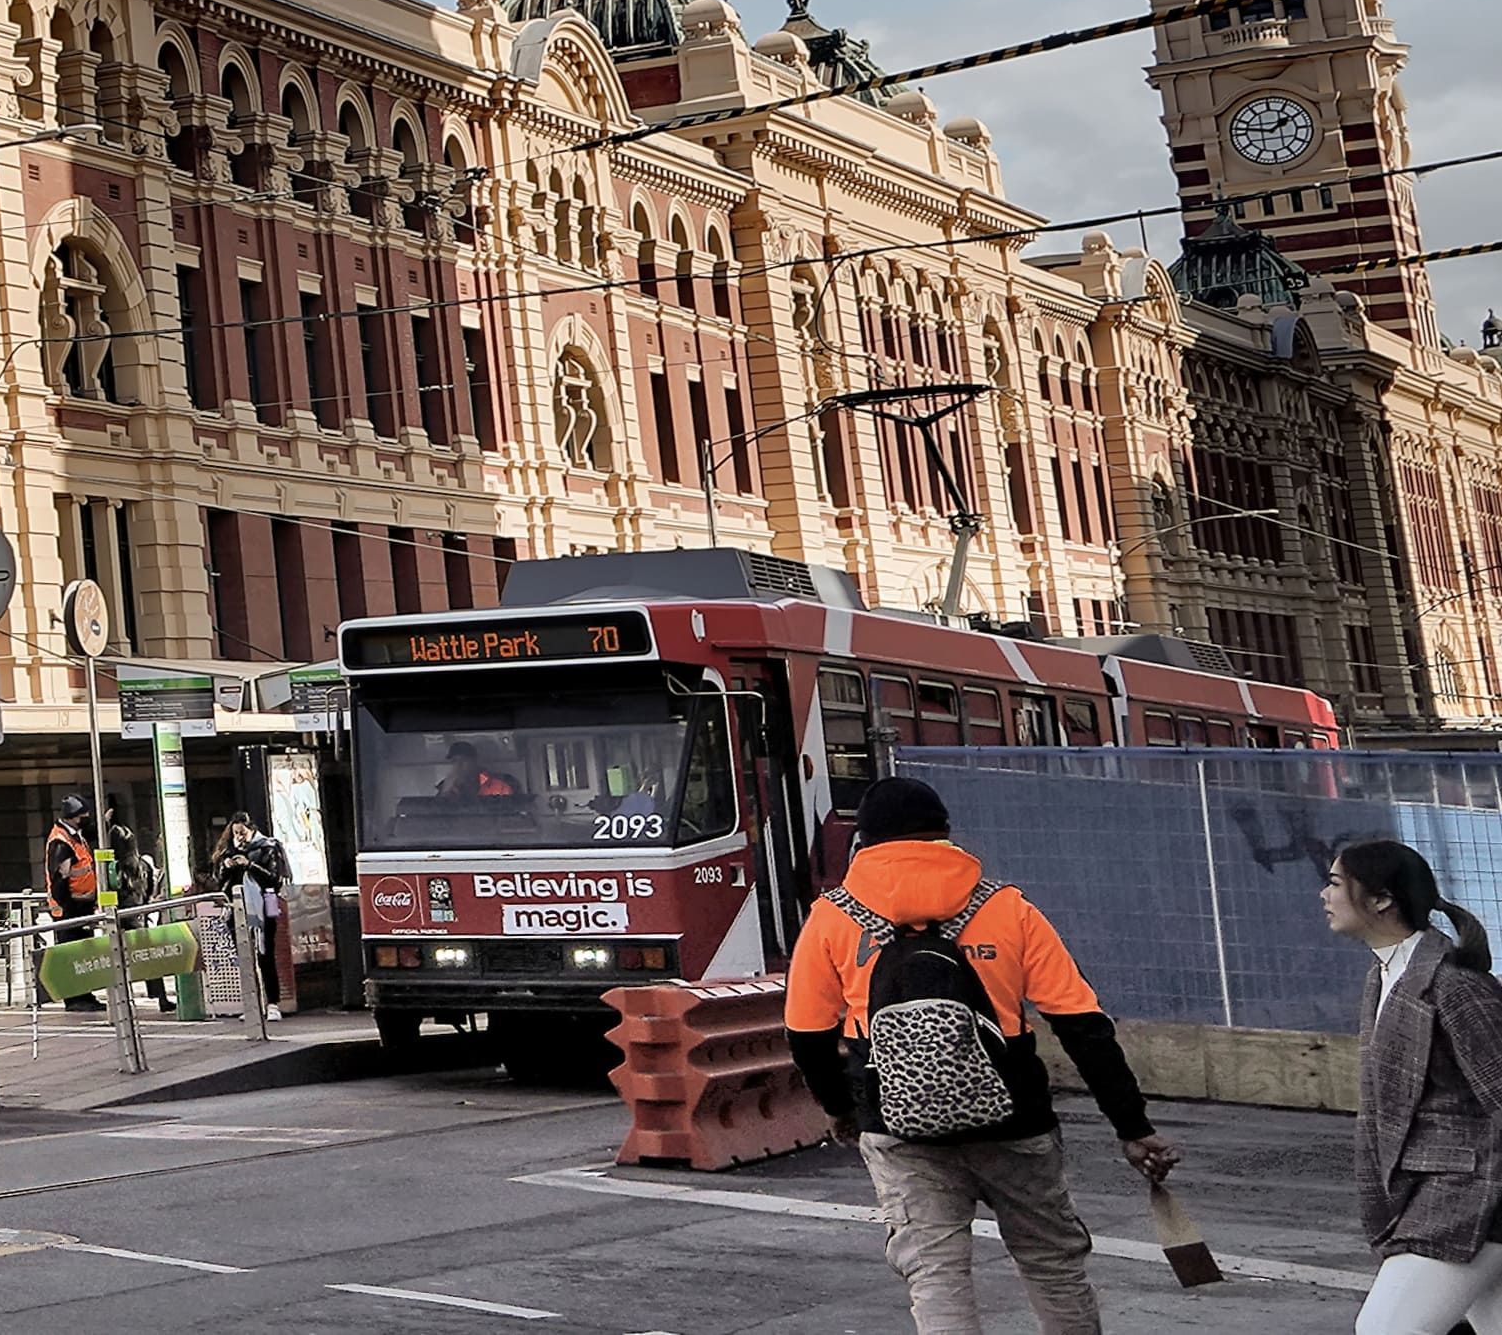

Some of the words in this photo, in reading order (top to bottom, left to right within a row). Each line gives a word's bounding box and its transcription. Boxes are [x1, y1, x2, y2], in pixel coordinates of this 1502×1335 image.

[410, 634, 479, 662] Wattle
[484, 631, 541, 658] Park
[587, 626, 620, 653] 70
[593, 815, 663, 840] 2093
[474, 873, 619, 902] Believing
[627, 872, 654, 898] is
[694, 867, 723, 884] 2093
[514, 905, 619, 931] magic.
